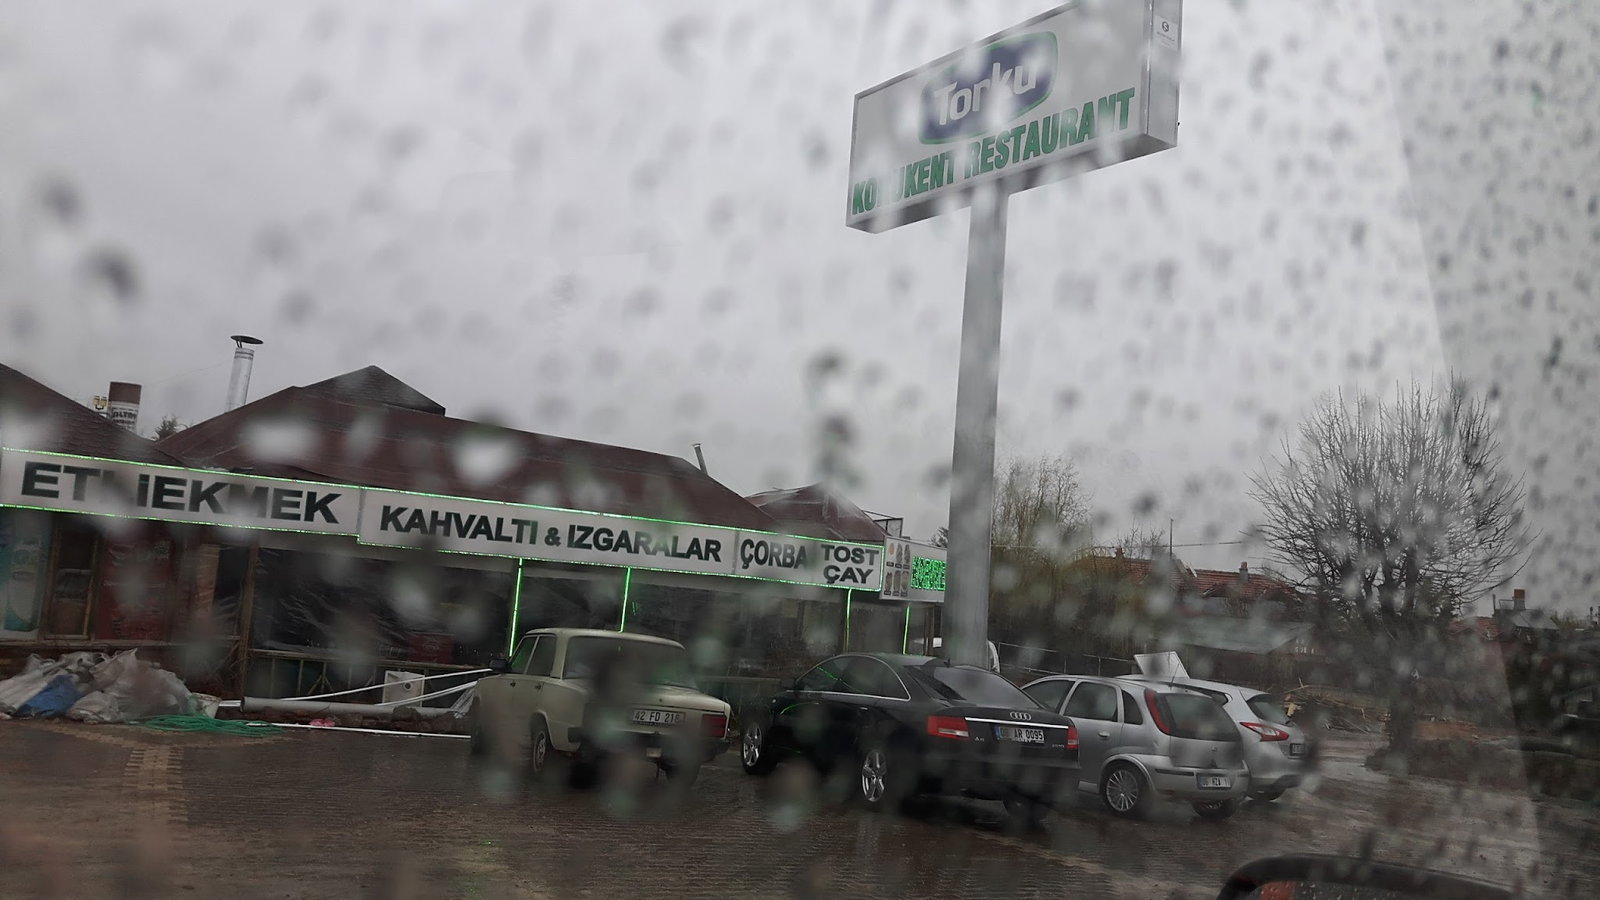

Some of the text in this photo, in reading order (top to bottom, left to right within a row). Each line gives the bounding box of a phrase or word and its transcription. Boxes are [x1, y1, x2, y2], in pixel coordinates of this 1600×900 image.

[933, 62, 1037, 125] Torku
[852, 87, 1135, 215] KOUKENT RESTAURANT
[380, 505, 721, 563] KAHVALTI & IZGARALAR
[740, 538, 879, 569] ÇORBA TOST
[824, 565, 873, 584] ÇAY
[1025, 730, 1043, 741] 0095
